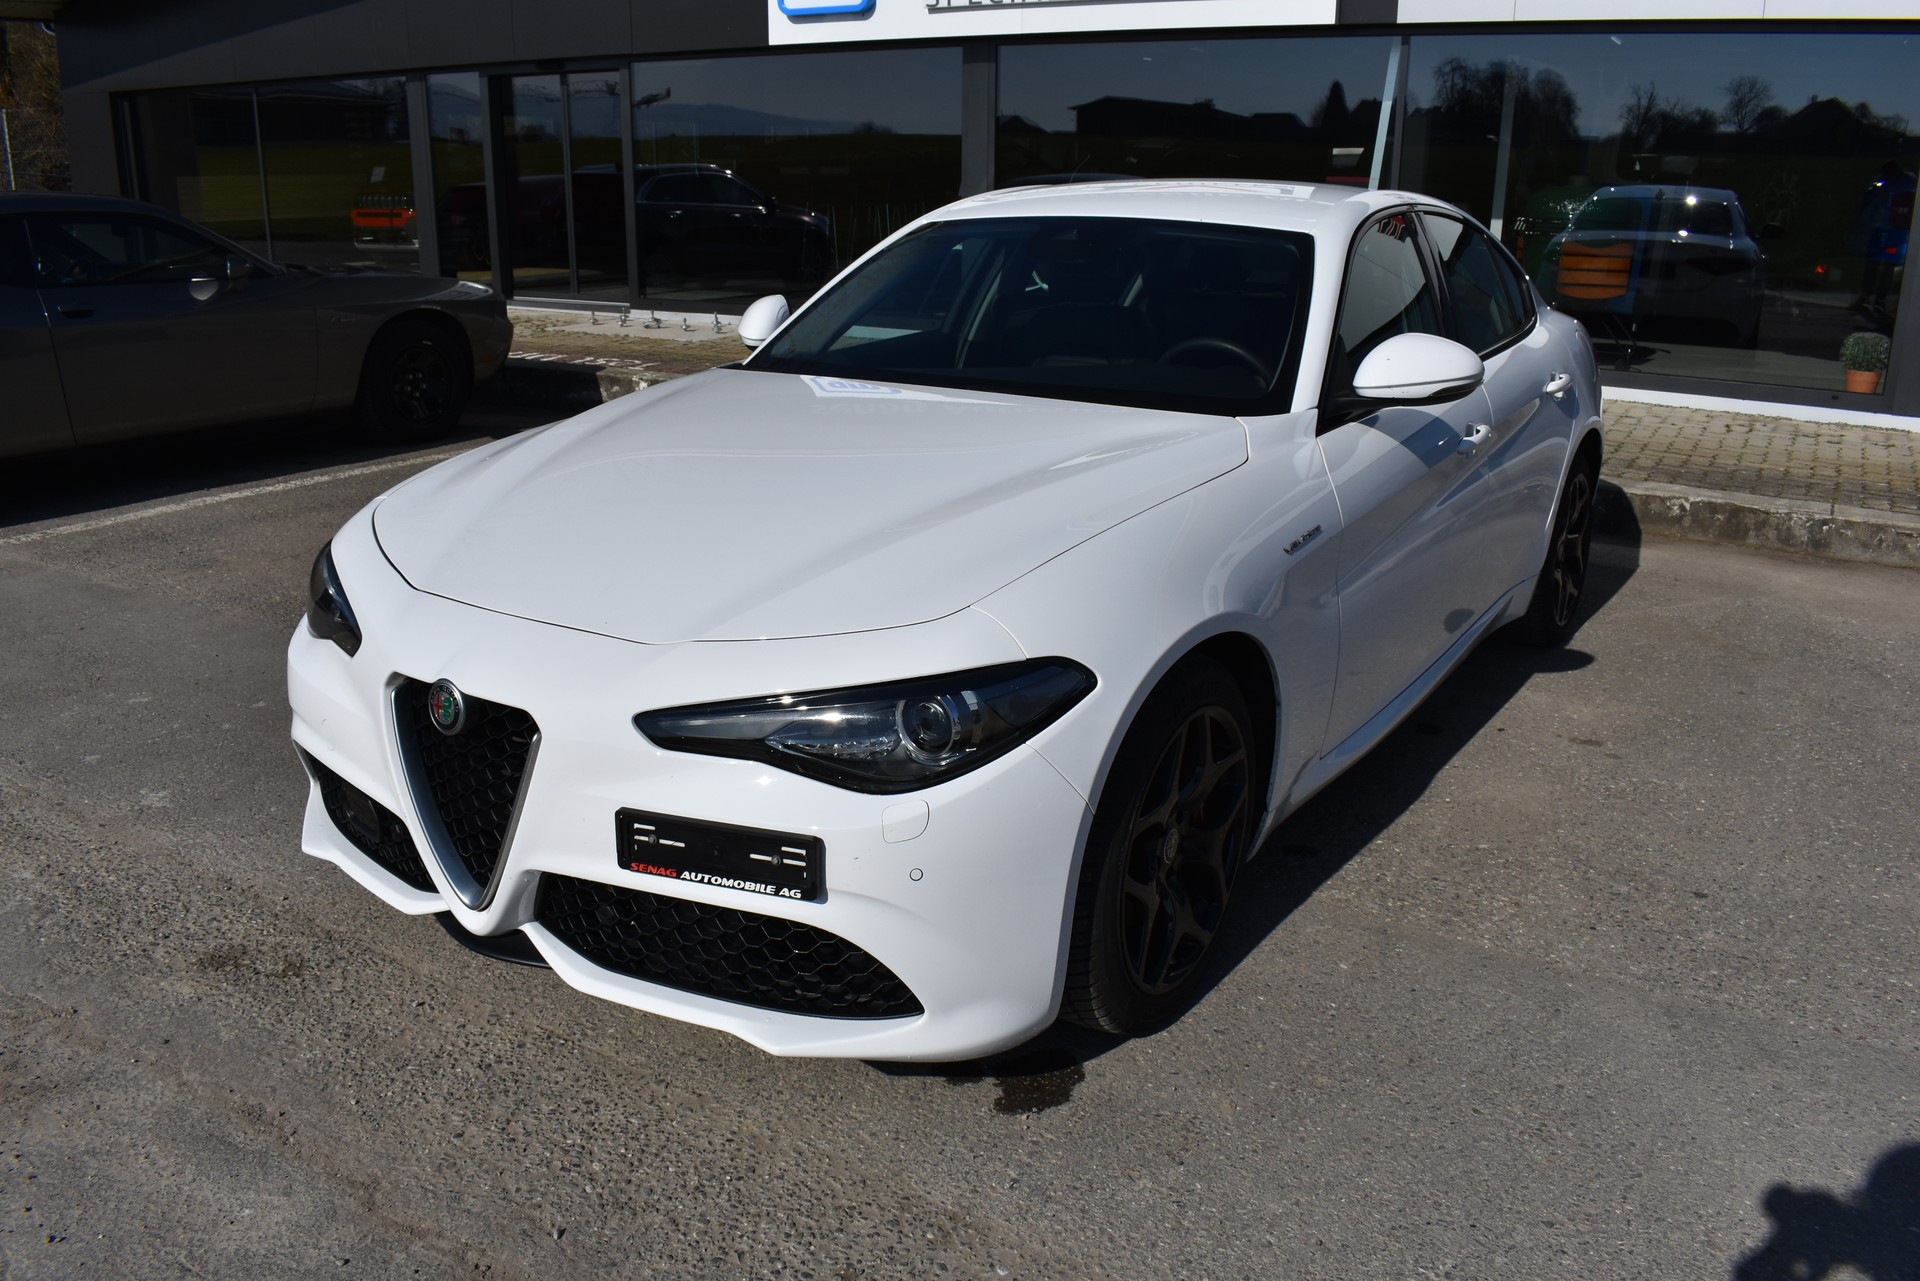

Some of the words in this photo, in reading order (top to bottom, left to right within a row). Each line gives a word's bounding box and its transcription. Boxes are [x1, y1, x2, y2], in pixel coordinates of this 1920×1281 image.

[630, 862, 677, 878] SENAG
[680, 871, 776, 895] AUTOMOBILE
[779, 887, 802, 899] AG
